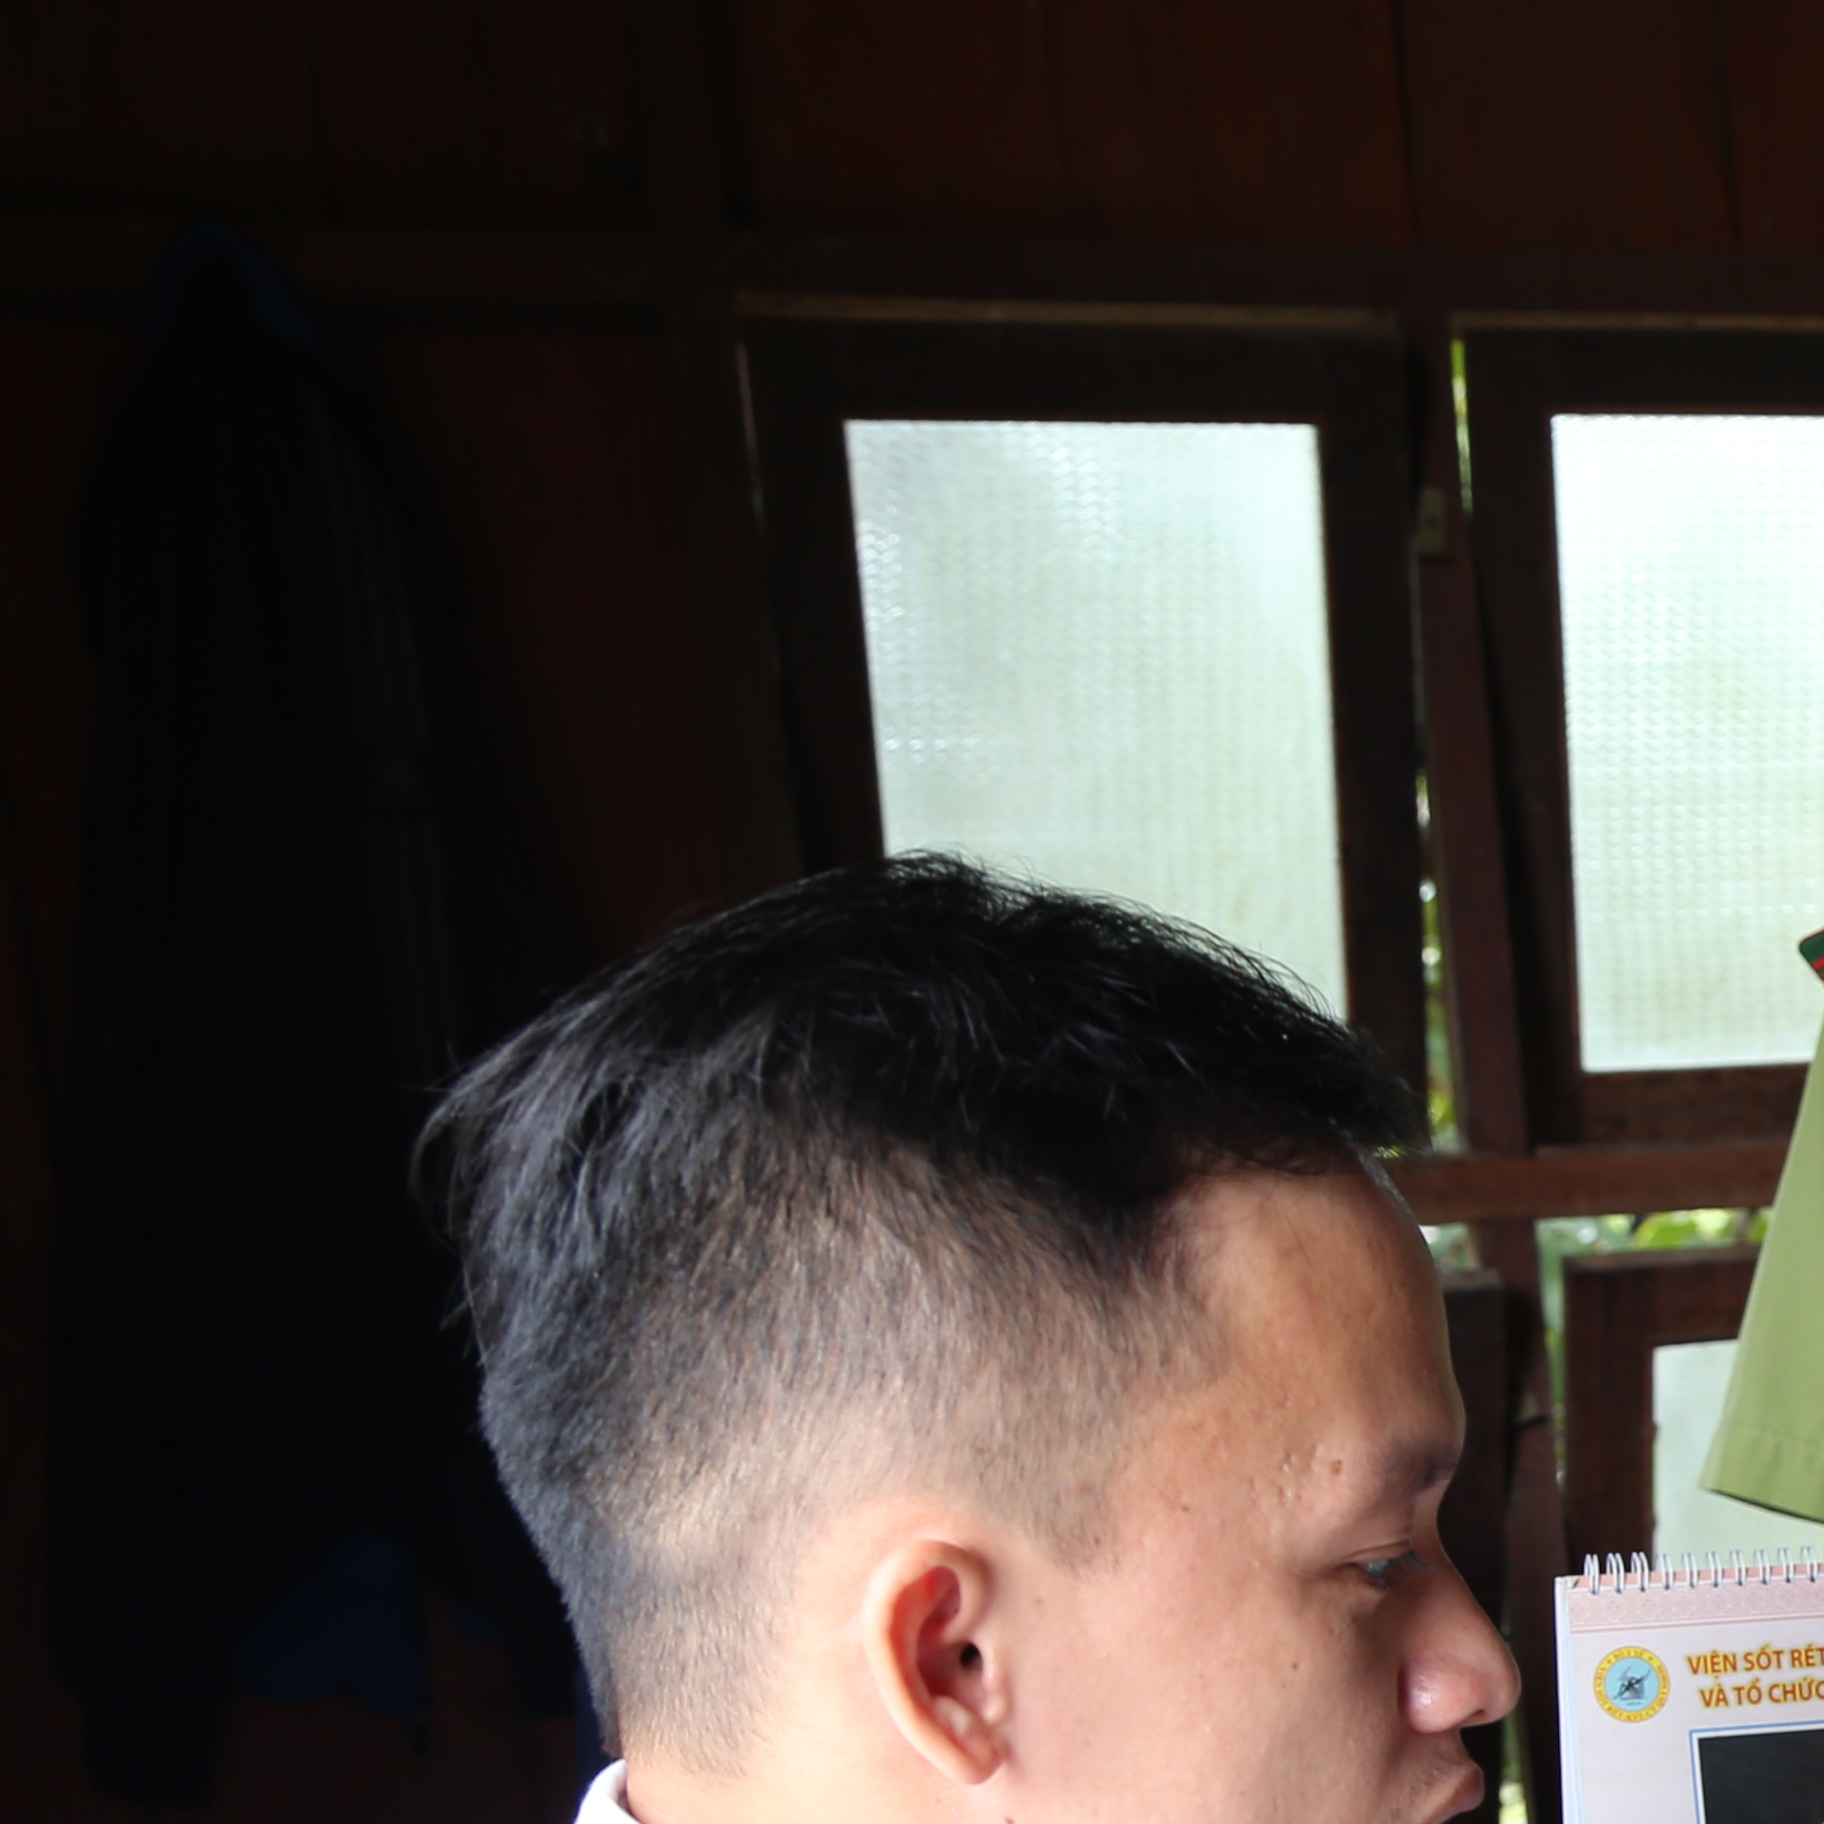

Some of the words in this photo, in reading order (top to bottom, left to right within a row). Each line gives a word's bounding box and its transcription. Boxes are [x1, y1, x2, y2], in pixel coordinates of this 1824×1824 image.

[1687, 1651, 1738, 1679] VIỆN
[1743, 1642, 1784, 1672] SỐT
[1701, 1684, 1729, 1709] VÀ
[1733, 1678, 1762, 1705] TỔ
